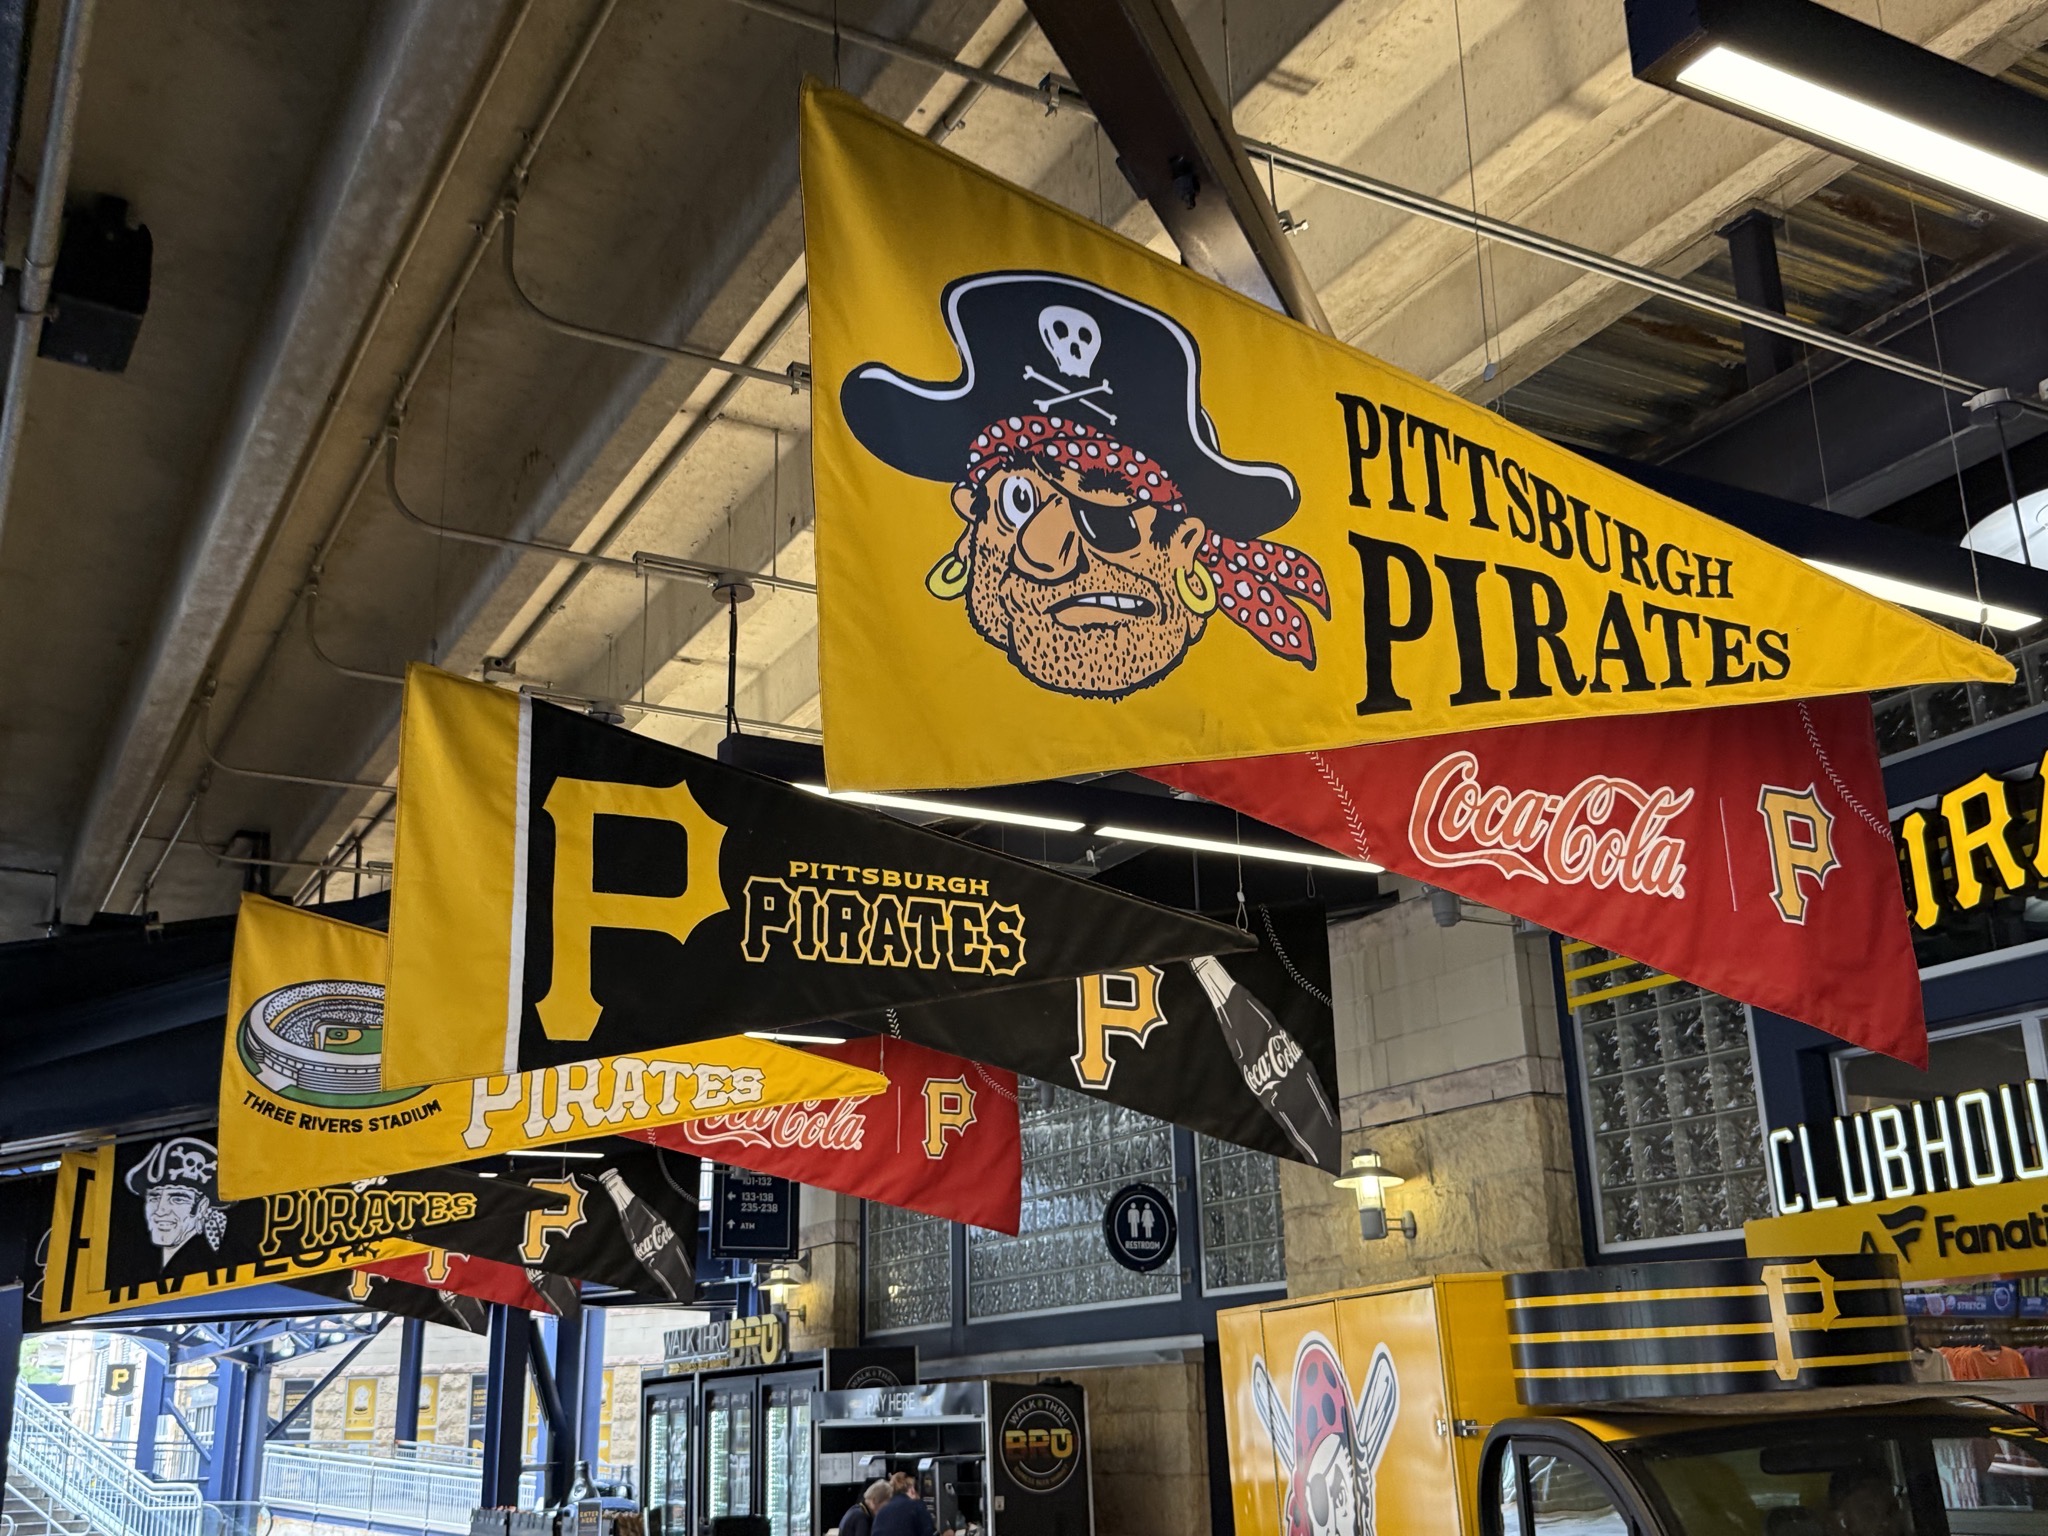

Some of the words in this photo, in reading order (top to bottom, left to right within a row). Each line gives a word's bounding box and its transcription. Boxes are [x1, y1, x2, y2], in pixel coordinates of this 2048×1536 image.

[1336, 391, 1735, 600] PITTSBURGH
[1348, 531, 1790, 717] PIRATES
[1757, 782, 1842, 926] P
[1902, 748, 2048, 930] IR
[535, 776, 731, 1041] P
[789, 860, 990, 897] PITTSBURGH
[741, 876, 1028, 977] PIRATES
[1070, 964, 1168, 1090] P
[242, 1090, 297, 1126] THREE
[298, 1112, 364, 1133] RIVERS
[368, 1099, 442, 1132] STADIUM
[461, 1056, 766, 1149] PIRATES
[683, 1095, 871, 1150] CaCola
[921, 1073, 977, 1160] P
[1768, 1079, 2048, 1215] CLUBHOU
[258, 1188, 478, 1257] PIRATES
[740, 1222, 755, 1230] ATM
[741, 1191, 774, 1202] 133-138
[741, 1202, 778, 1213] 235-238
[1125, 1240, 1160, 1249] RESTROOM
[1760, 1259, 1841, 1381] P
[1957, 1300, 1986, 1311] STRETCH
[664, 1325, 697, 1356] WALK
[697, 1320, 730, 1353] THRU
[112, 1368, 129, 1391] P
[867, 1393, 887, 1414] PAY
[888, 1391, 915, 1412] HERE
[1009, 1399, 1037, 1425] WALK
[1044, 1399, 1070, 1424] THRU
